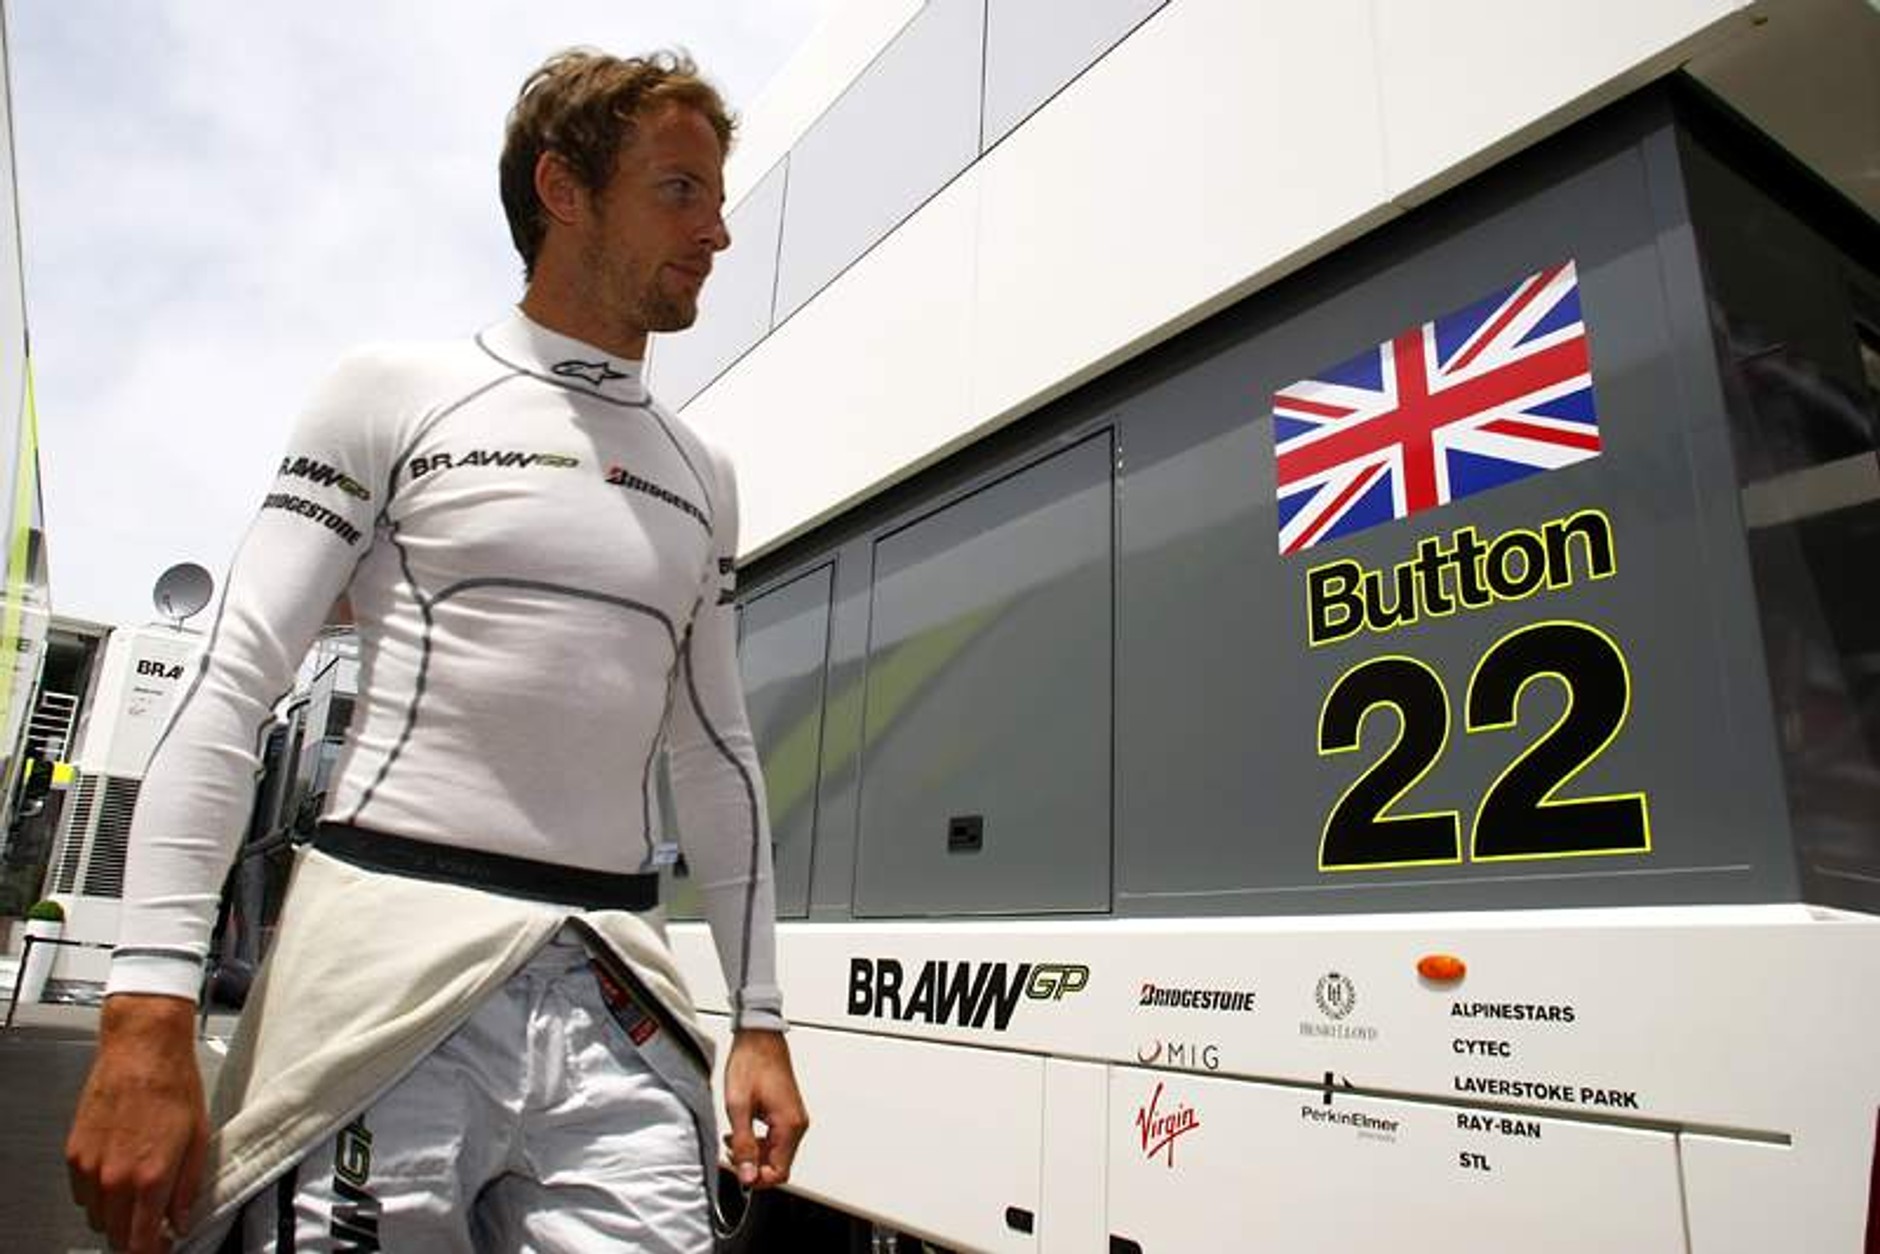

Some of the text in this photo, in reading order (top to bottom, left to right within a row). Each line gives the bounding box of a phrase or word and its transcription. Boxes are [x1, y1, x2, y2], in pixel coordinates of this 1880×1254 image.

[1307, 509, 1616, 647] Button
[137, 660, 184, 680] BRA
[1318, 619, 1651, 872] 22
[1139, 983, 1256, 1011] BRIDGESTONE
[1450, 1002, 1576, 1023] ALPINESTARS
[1167, 1042, 1220, 1071] MIG
[1452, 1039, 1511, 1058] CYTEC
[1454, 1076, 1640, 1109] LAVERSTOKE PARK
[1135, 1082, 1200, 1167] Virgin
[1301, 1105, 1399, 1132] PerkinElmer
[1456, 1113, 1542, 1139] RAY-BAN
[1459, 1152, 1491, 1171] STL
